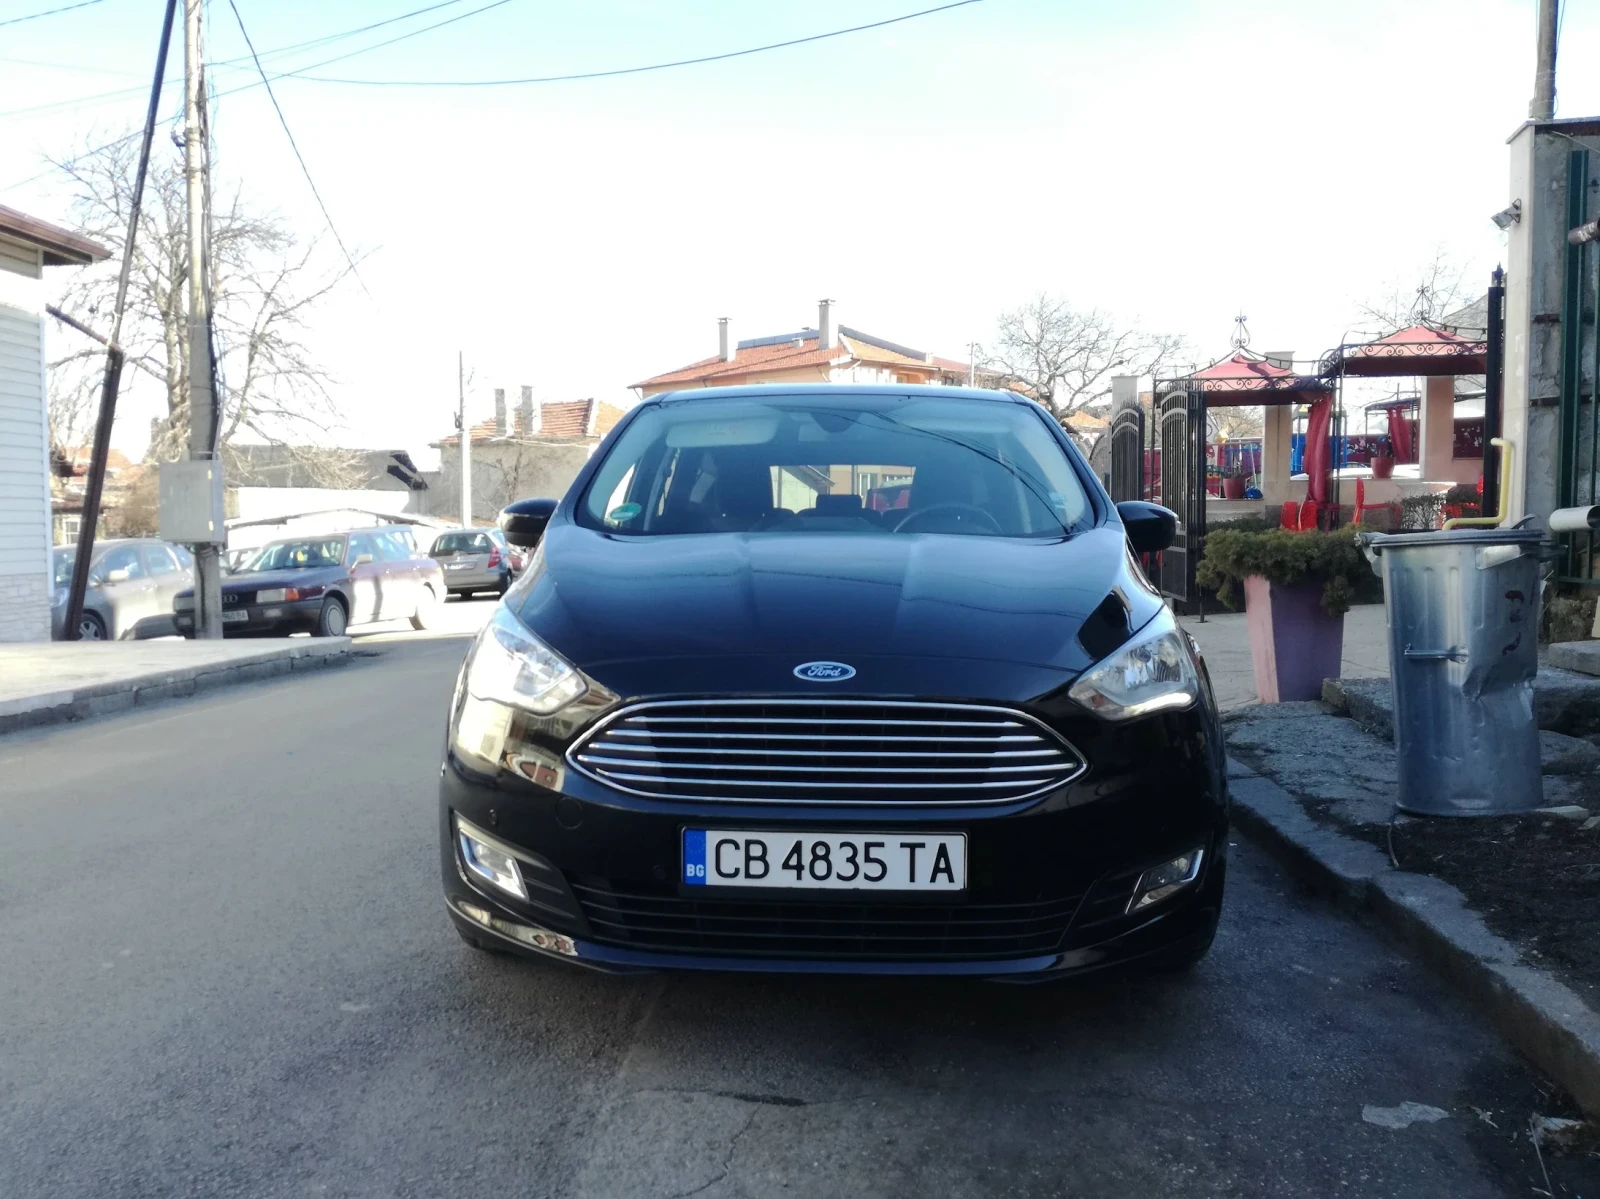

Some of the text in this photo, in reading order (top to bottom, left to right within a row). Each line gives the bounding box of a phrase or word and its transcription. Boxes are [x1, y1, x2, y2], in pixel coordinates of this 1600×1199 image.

[807, 665, 841, 676] Ford
[715, 839, 955, 883] CB 4835 TA
[686, 864, 704, 877] BG
